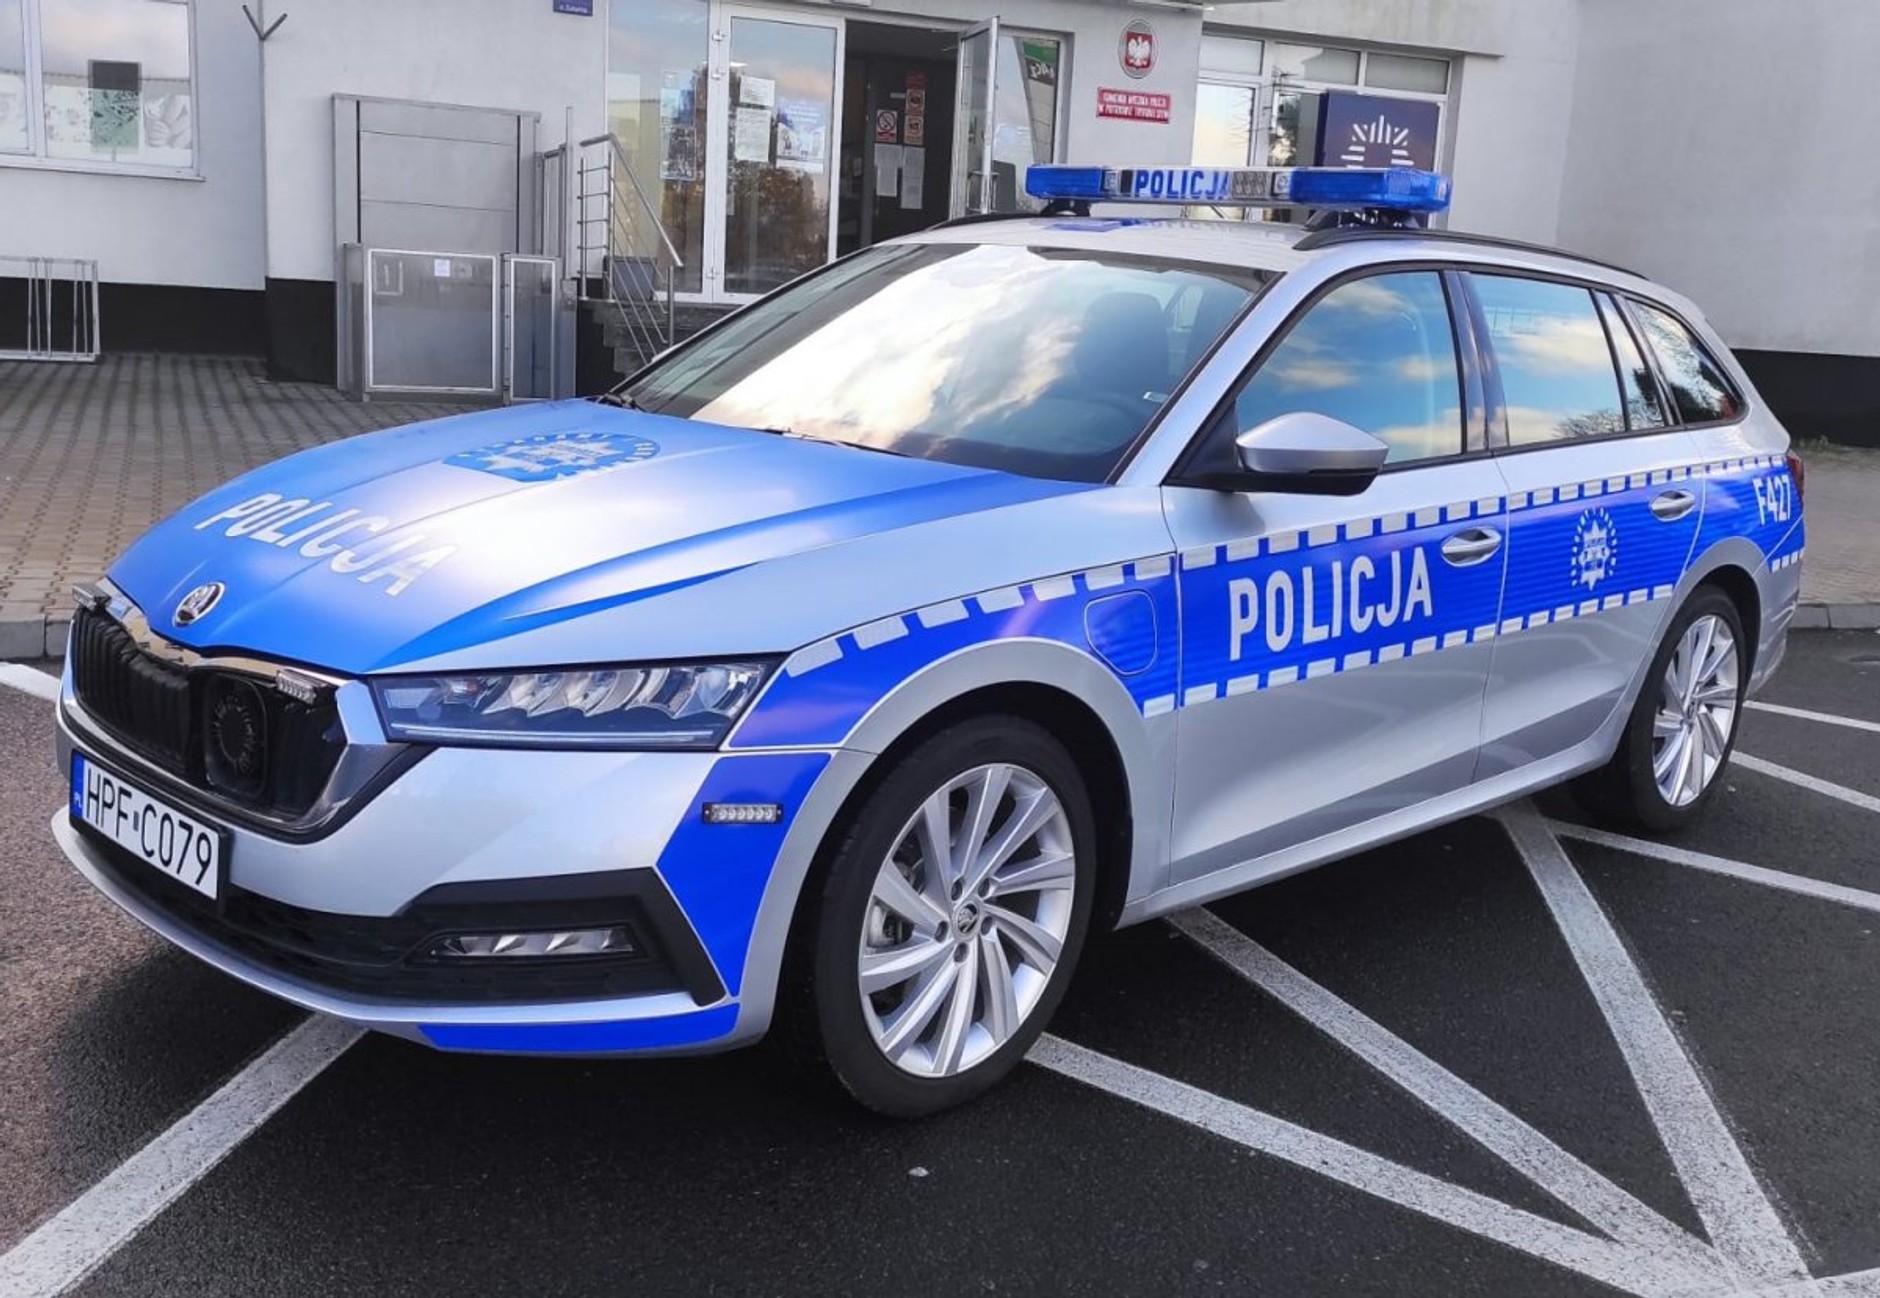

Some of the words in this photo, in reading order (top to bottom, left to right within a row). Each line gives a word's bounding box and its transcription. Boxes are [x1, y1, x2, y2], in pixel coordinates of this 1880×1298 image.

[193, 493, 455, 597] POLICJA
[1753, 474, 1790, 526] F427
[1229, 547, 1433, 661] POLICJA
[86, 767, 133, 839] HPF
[141, 803, 212, 886] C079
